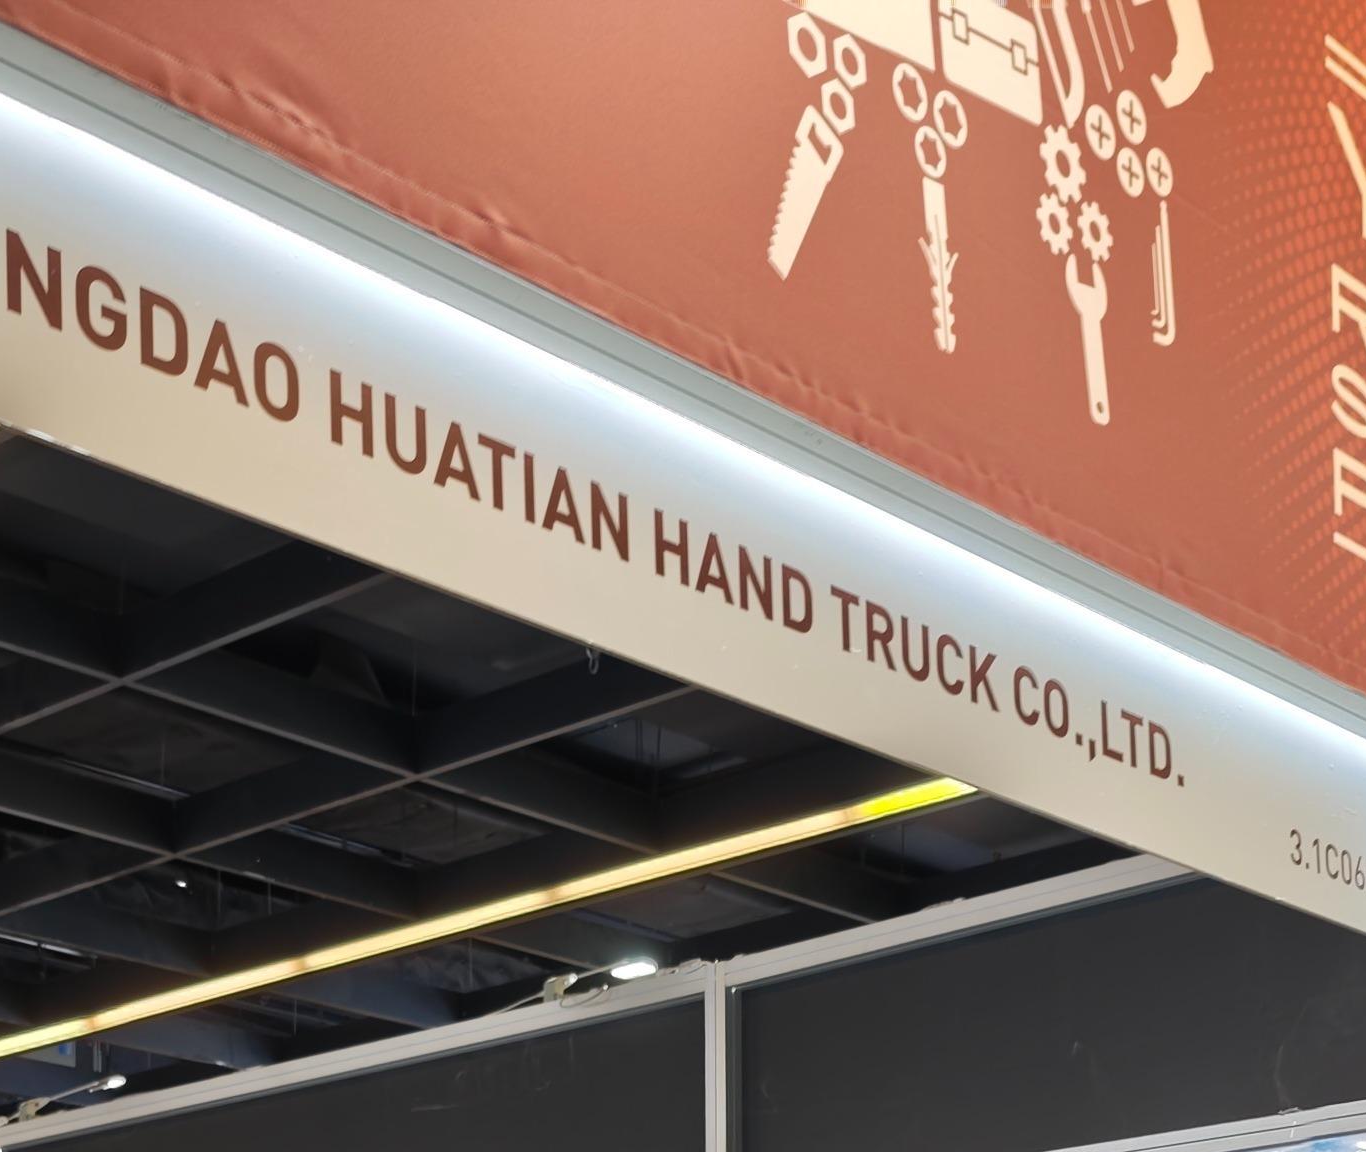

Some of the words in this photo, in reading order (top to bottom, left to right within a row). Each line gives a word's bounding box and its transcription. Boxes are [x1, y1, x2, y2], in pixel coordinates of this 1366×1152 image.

[329, 368, 629, 563] HUATIAN
[654, 507, 814, 635] HAND
[830, 584, 1001, 713] TRUCK
[1013, 666, 1186, 787] CO.,LTD.
